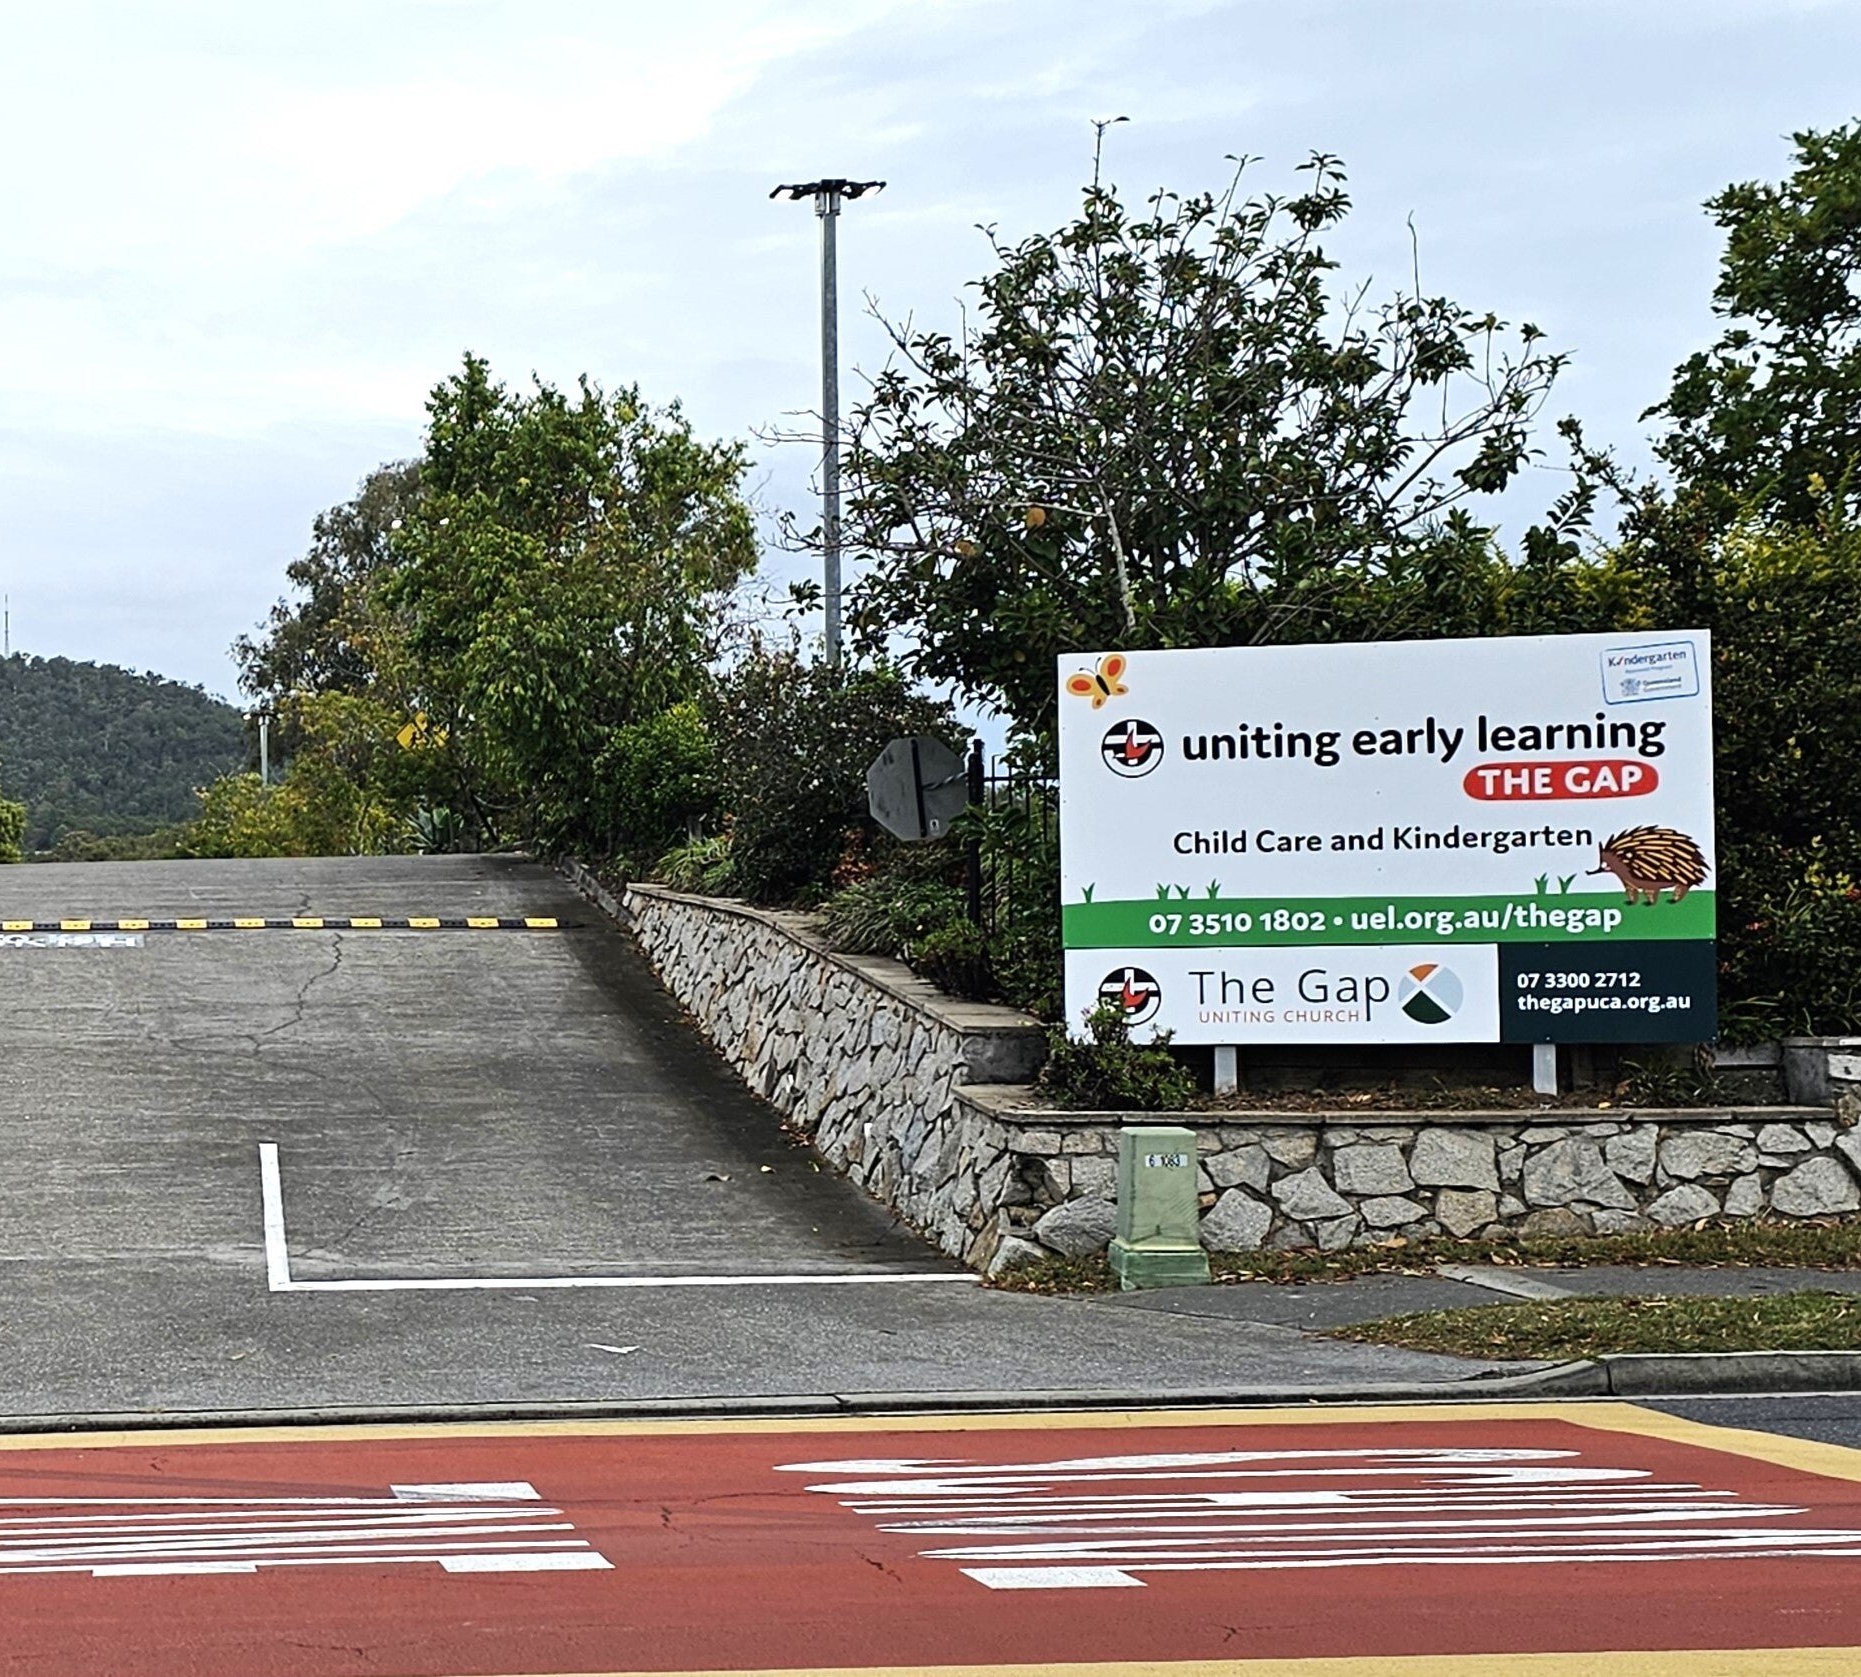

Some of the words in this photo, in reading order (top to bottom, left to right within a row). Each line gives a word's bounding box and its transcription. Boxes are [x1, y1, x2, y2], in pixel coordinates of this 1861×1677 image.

[1183, 722, 1342, 767] uniting
[1352, 716, 1464, 764] early
[1478, 712, 1667, 758] learning
[1476, 767, 1554, 797] THE
[1563, 763, 1644, 795] GAP
[1173, 829, 1247, 854] Child
[1255, 829, 1322, 853] Care
[1330, 826, 1384, 852] and
[1393, 824, 1592, 854] Kindergarten
[1149, 914, 1182, 935] 07
[1189, 913, 1252, 935] 3510
[1259, 909, 1326, 931] 1802
[1351, 902, 1622, 935] uel.org.au/thegap
[1188, 971, 1275, 1005] The
[1297, 969, 1390, 1022] Gap
[1517, 973, 1540, 988] 07
[1544, 972, 1590, 988] 3300
[1594, 972, 1641, 988] 2712
[1199, 1010, 1275, 1024] UNITING
[1283, 1009, 1359, 1023] CHURCH
[1517, 994, 1691, 1014] thegapuca.org.au
[774, 1448, 1861, 1590] SCHOOL
